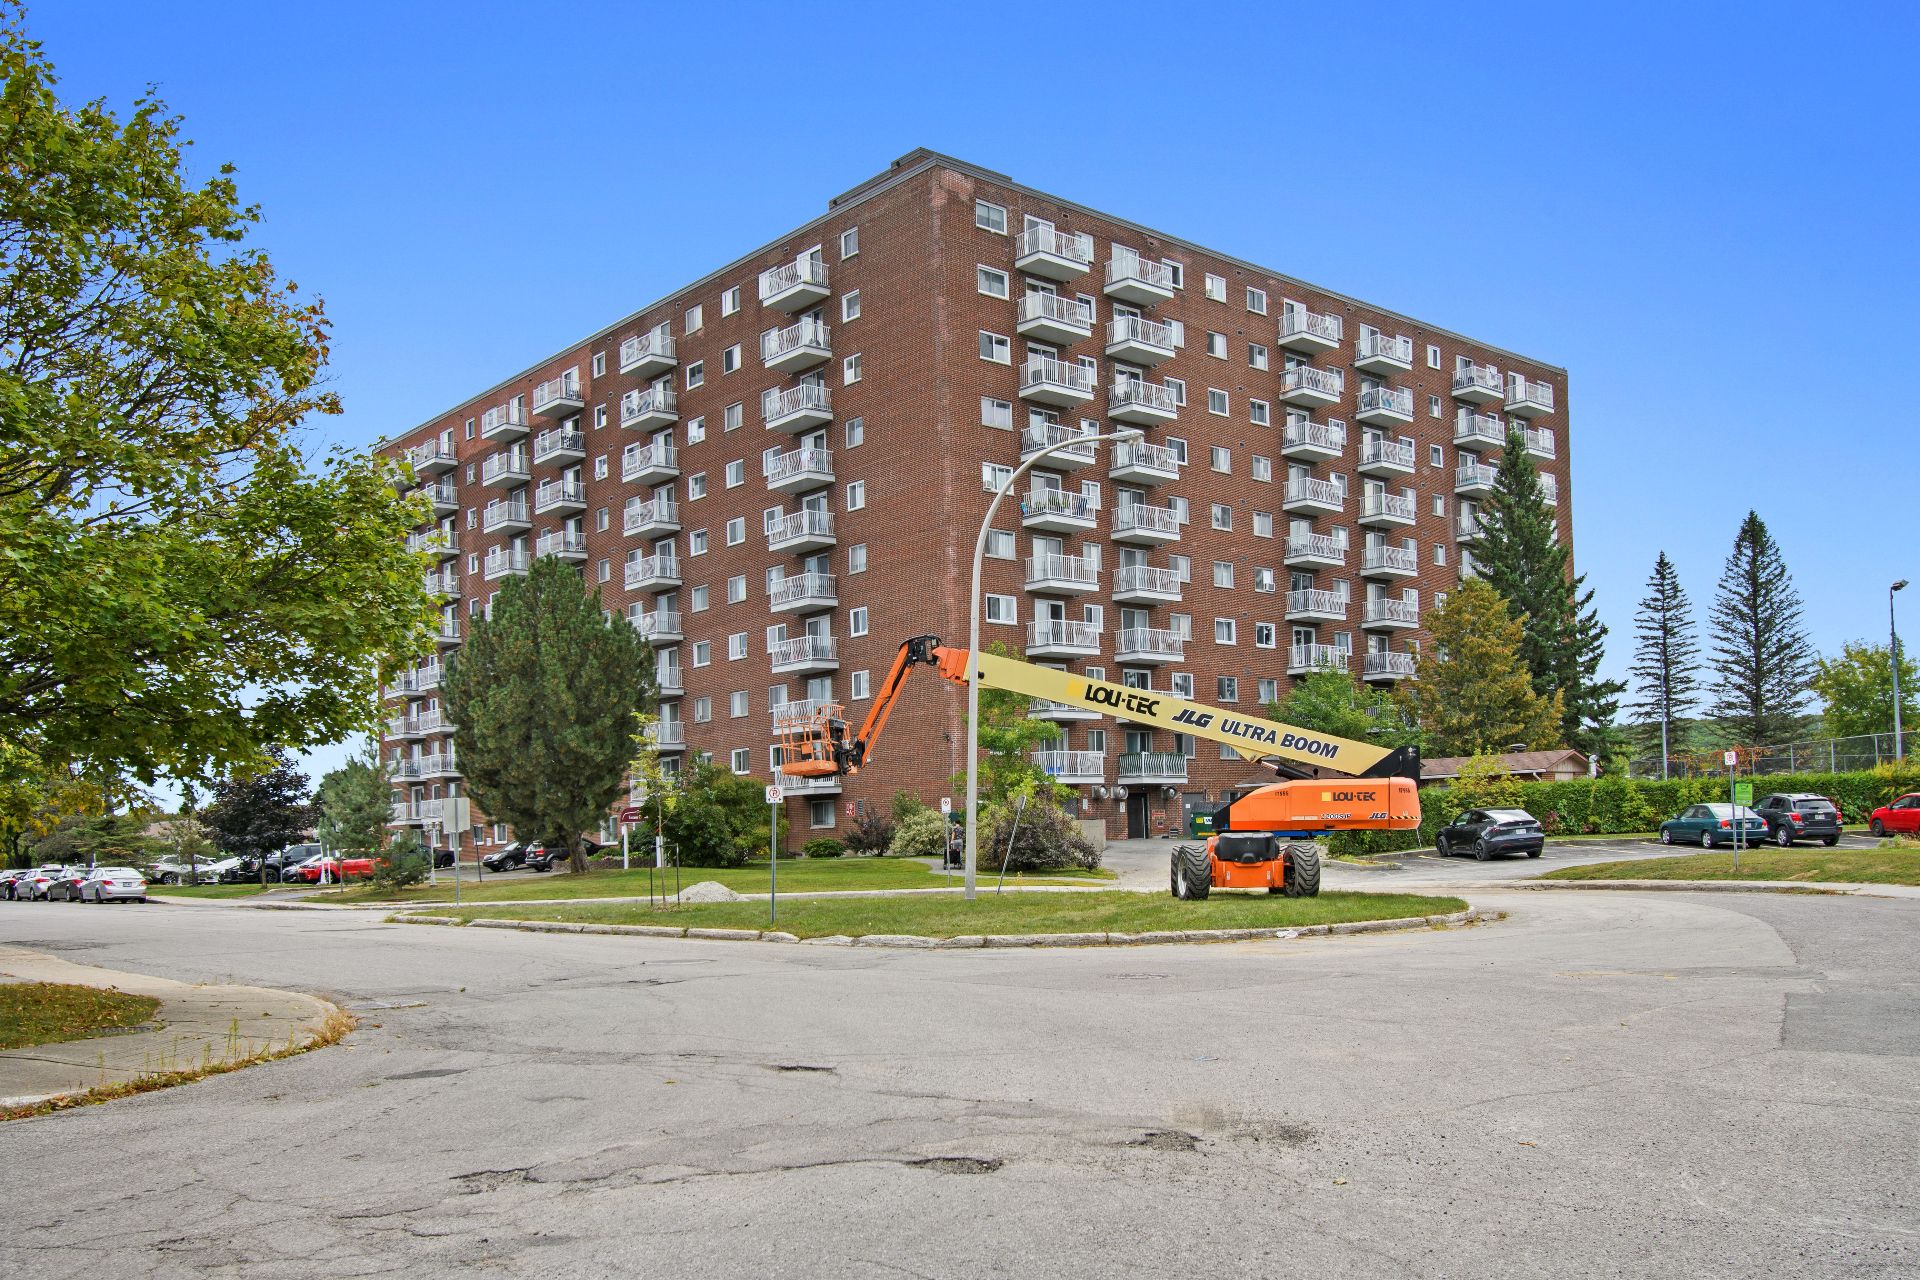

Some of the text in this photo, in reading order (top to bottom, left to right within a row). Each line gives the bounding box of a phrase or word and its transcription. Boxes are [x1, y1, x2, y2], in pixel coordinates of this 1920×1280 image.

[1171, 708, 1214, 728] JLG
[1221, 718, 1277, 745] ULTRA
[1280, 733, 1340, 759] BOOM
